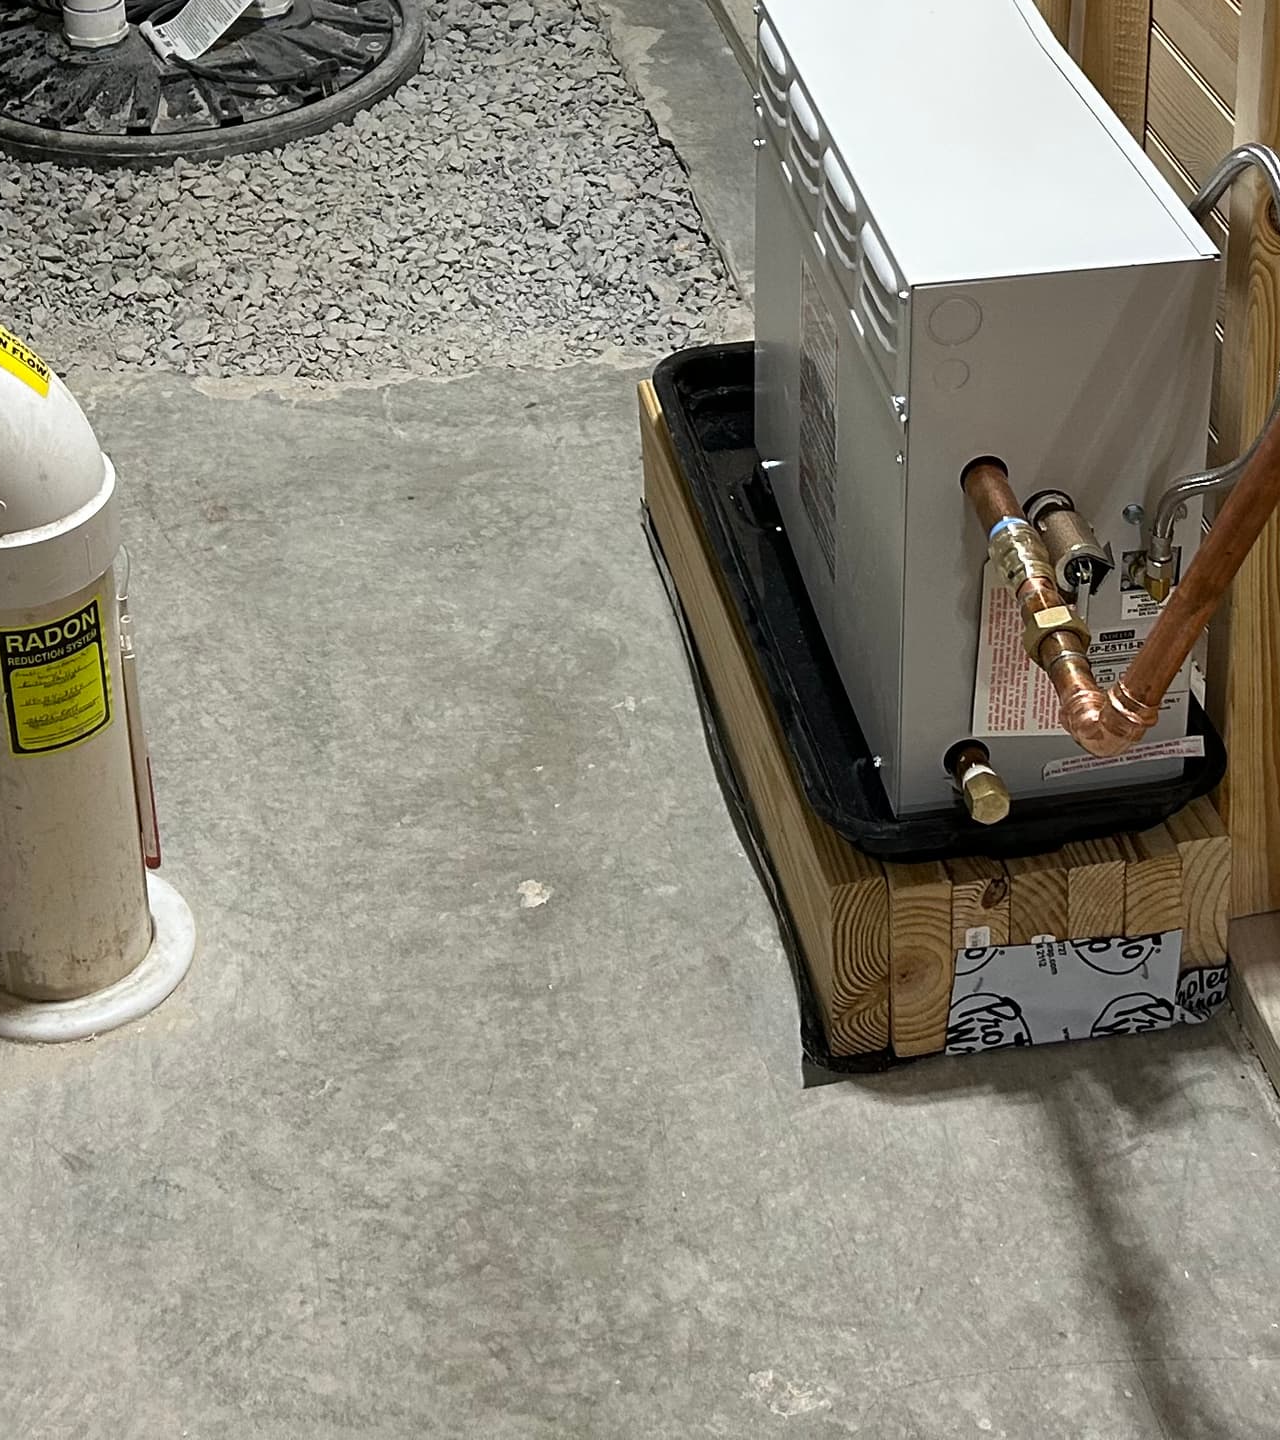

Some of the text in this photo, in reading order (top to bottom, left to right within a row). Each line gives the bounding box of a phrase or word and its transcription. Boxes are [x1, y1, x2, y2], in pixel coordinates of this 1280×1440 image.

[12, 347, 47, 377] FLOW
[6, 606, 96, 653] RADON
[7, 628, 98, 666] REDUCTION SYSTEM
